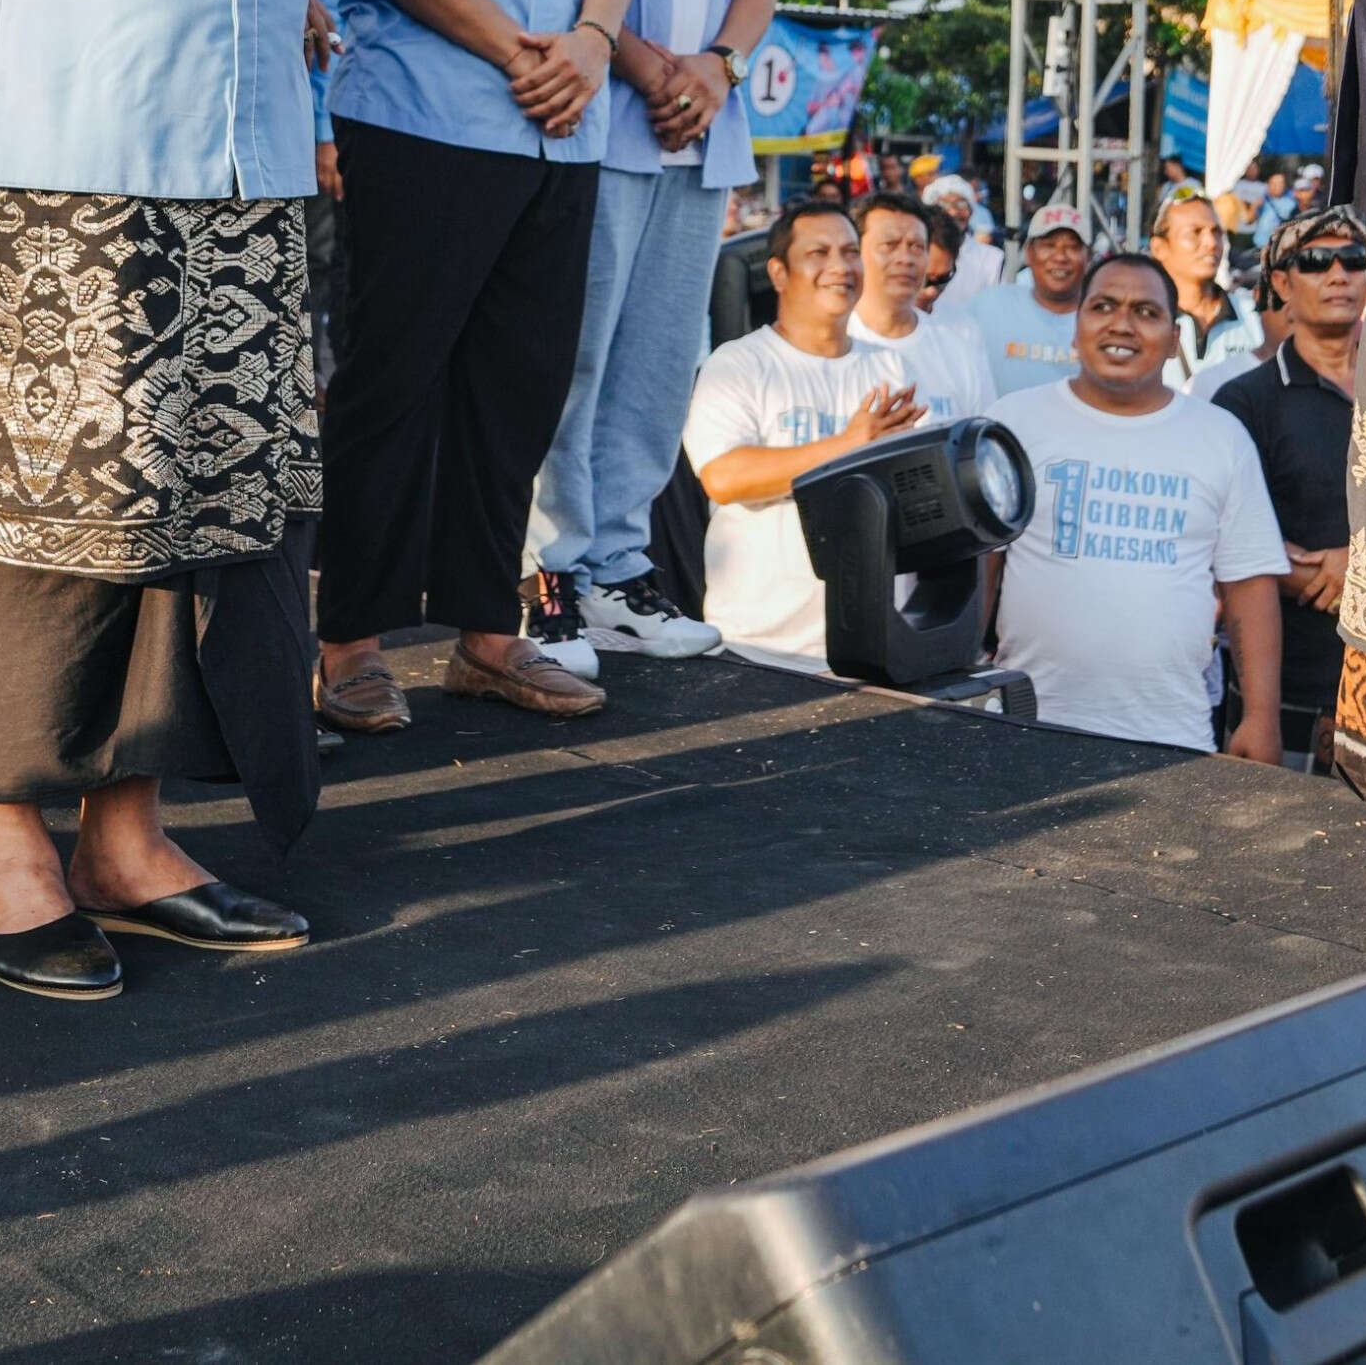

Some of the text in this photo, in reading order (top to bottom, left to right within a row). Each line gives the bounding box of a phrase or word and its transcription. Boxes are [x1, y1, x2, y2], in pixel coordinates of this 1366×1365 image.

[761, 58, 777, 102] 1
[1091, 466, 1189, 501] JOKOWI
[1087, 499, 1187, 537] GIBRAN
